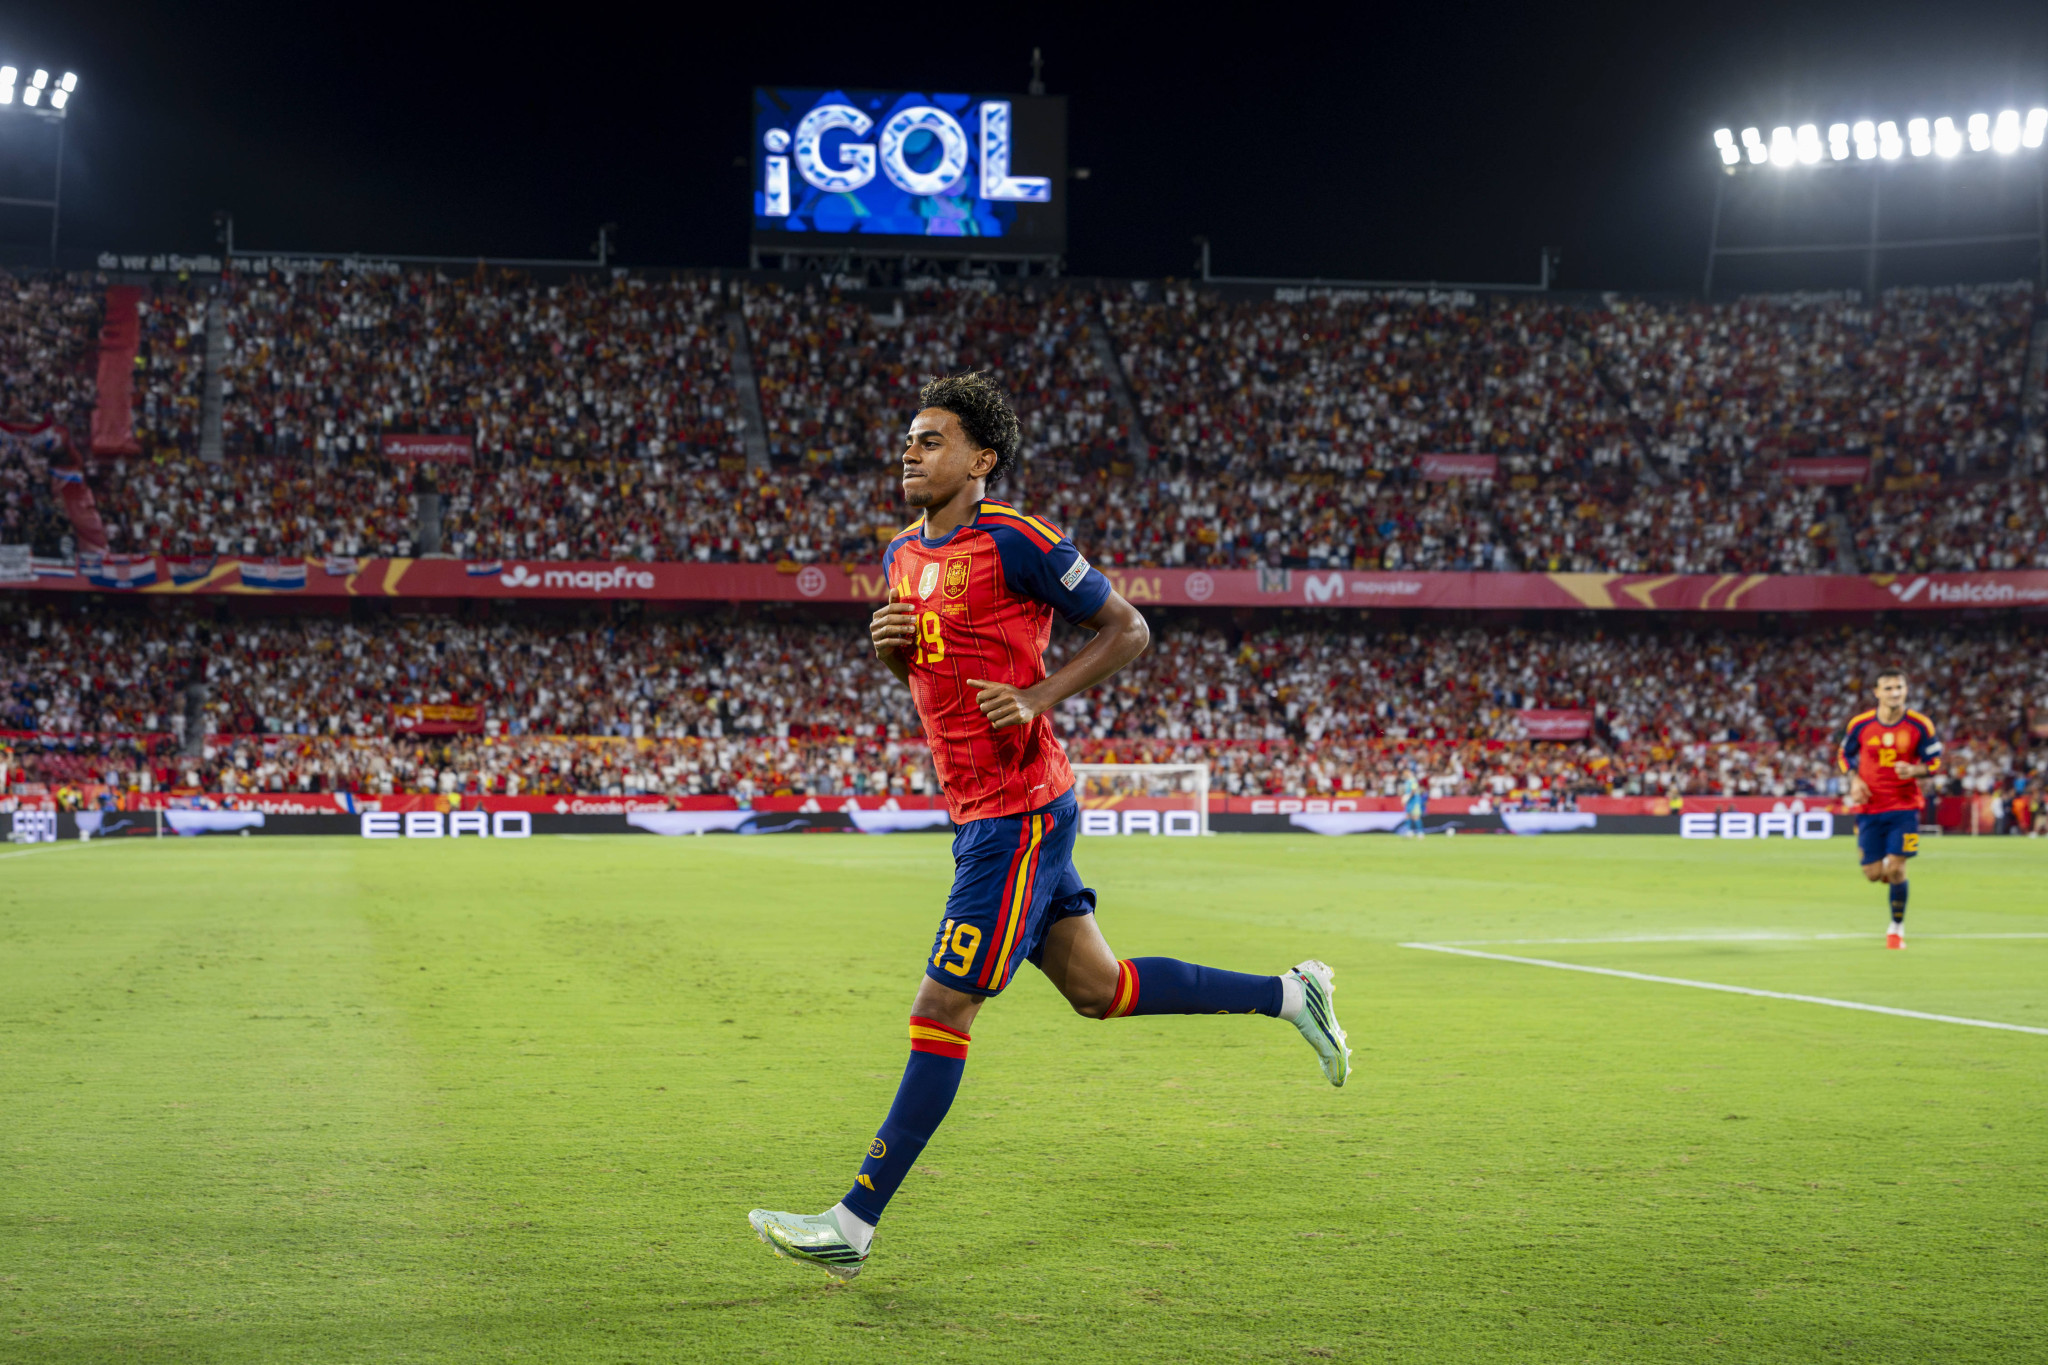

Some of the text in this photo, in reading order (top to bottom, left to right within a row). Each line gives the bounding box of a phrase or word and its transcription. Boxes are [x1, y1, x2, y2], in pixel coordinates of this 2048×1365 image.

[544, 567, 655, 592] mapfre
[1929, 581, 2015, 602] Halcón
[1879, 748, 1897, 767] 12
[361, 811, 533, 839] EBRO
[1080, 809, 1200, 836] BRO
[1679, 812, 1834, 840] EBRO
[1902, 832, 1920, 852] 12
[933, 918, 982, 977] 19
